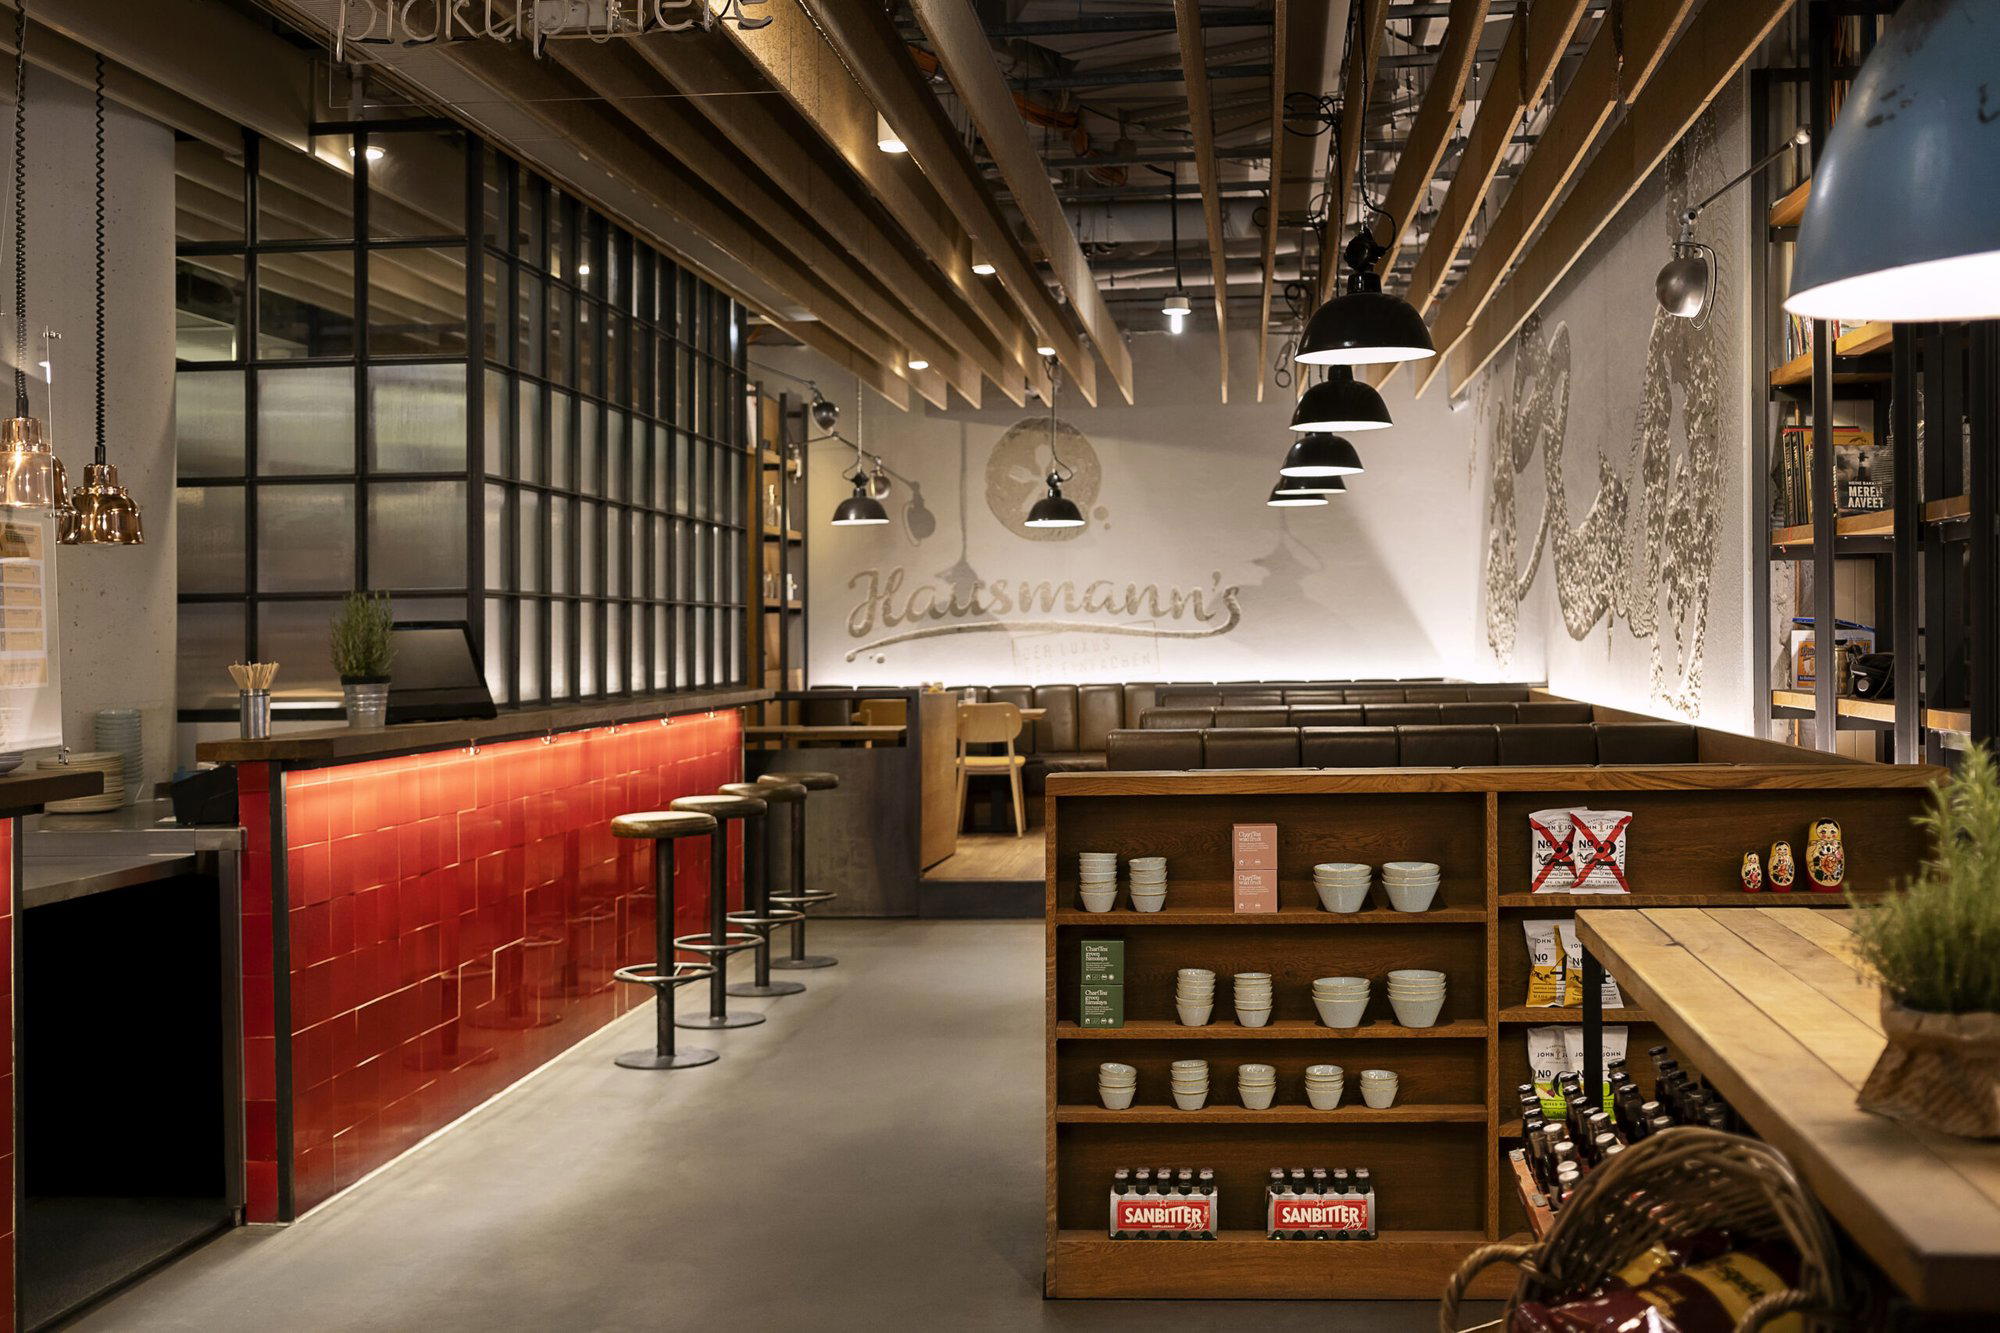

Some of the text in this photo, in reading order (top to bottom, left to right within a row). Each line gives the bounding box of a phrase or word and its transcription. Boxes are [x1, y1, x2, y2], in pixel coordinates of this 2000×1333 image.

[1848, 497, 1884, 508] AAVEET
[847, 566, 1241, 639] Hausmann's
[1537, 1069, 1552, 1078] NO
[1125, 1205, 1202, 1224] SANBITTER
[1281, 1205, 1360, 1224] SANBITTER
[1185, 1221, 1206, 1231] Dry
[1342, 1220, 1363, 1231] Dry
